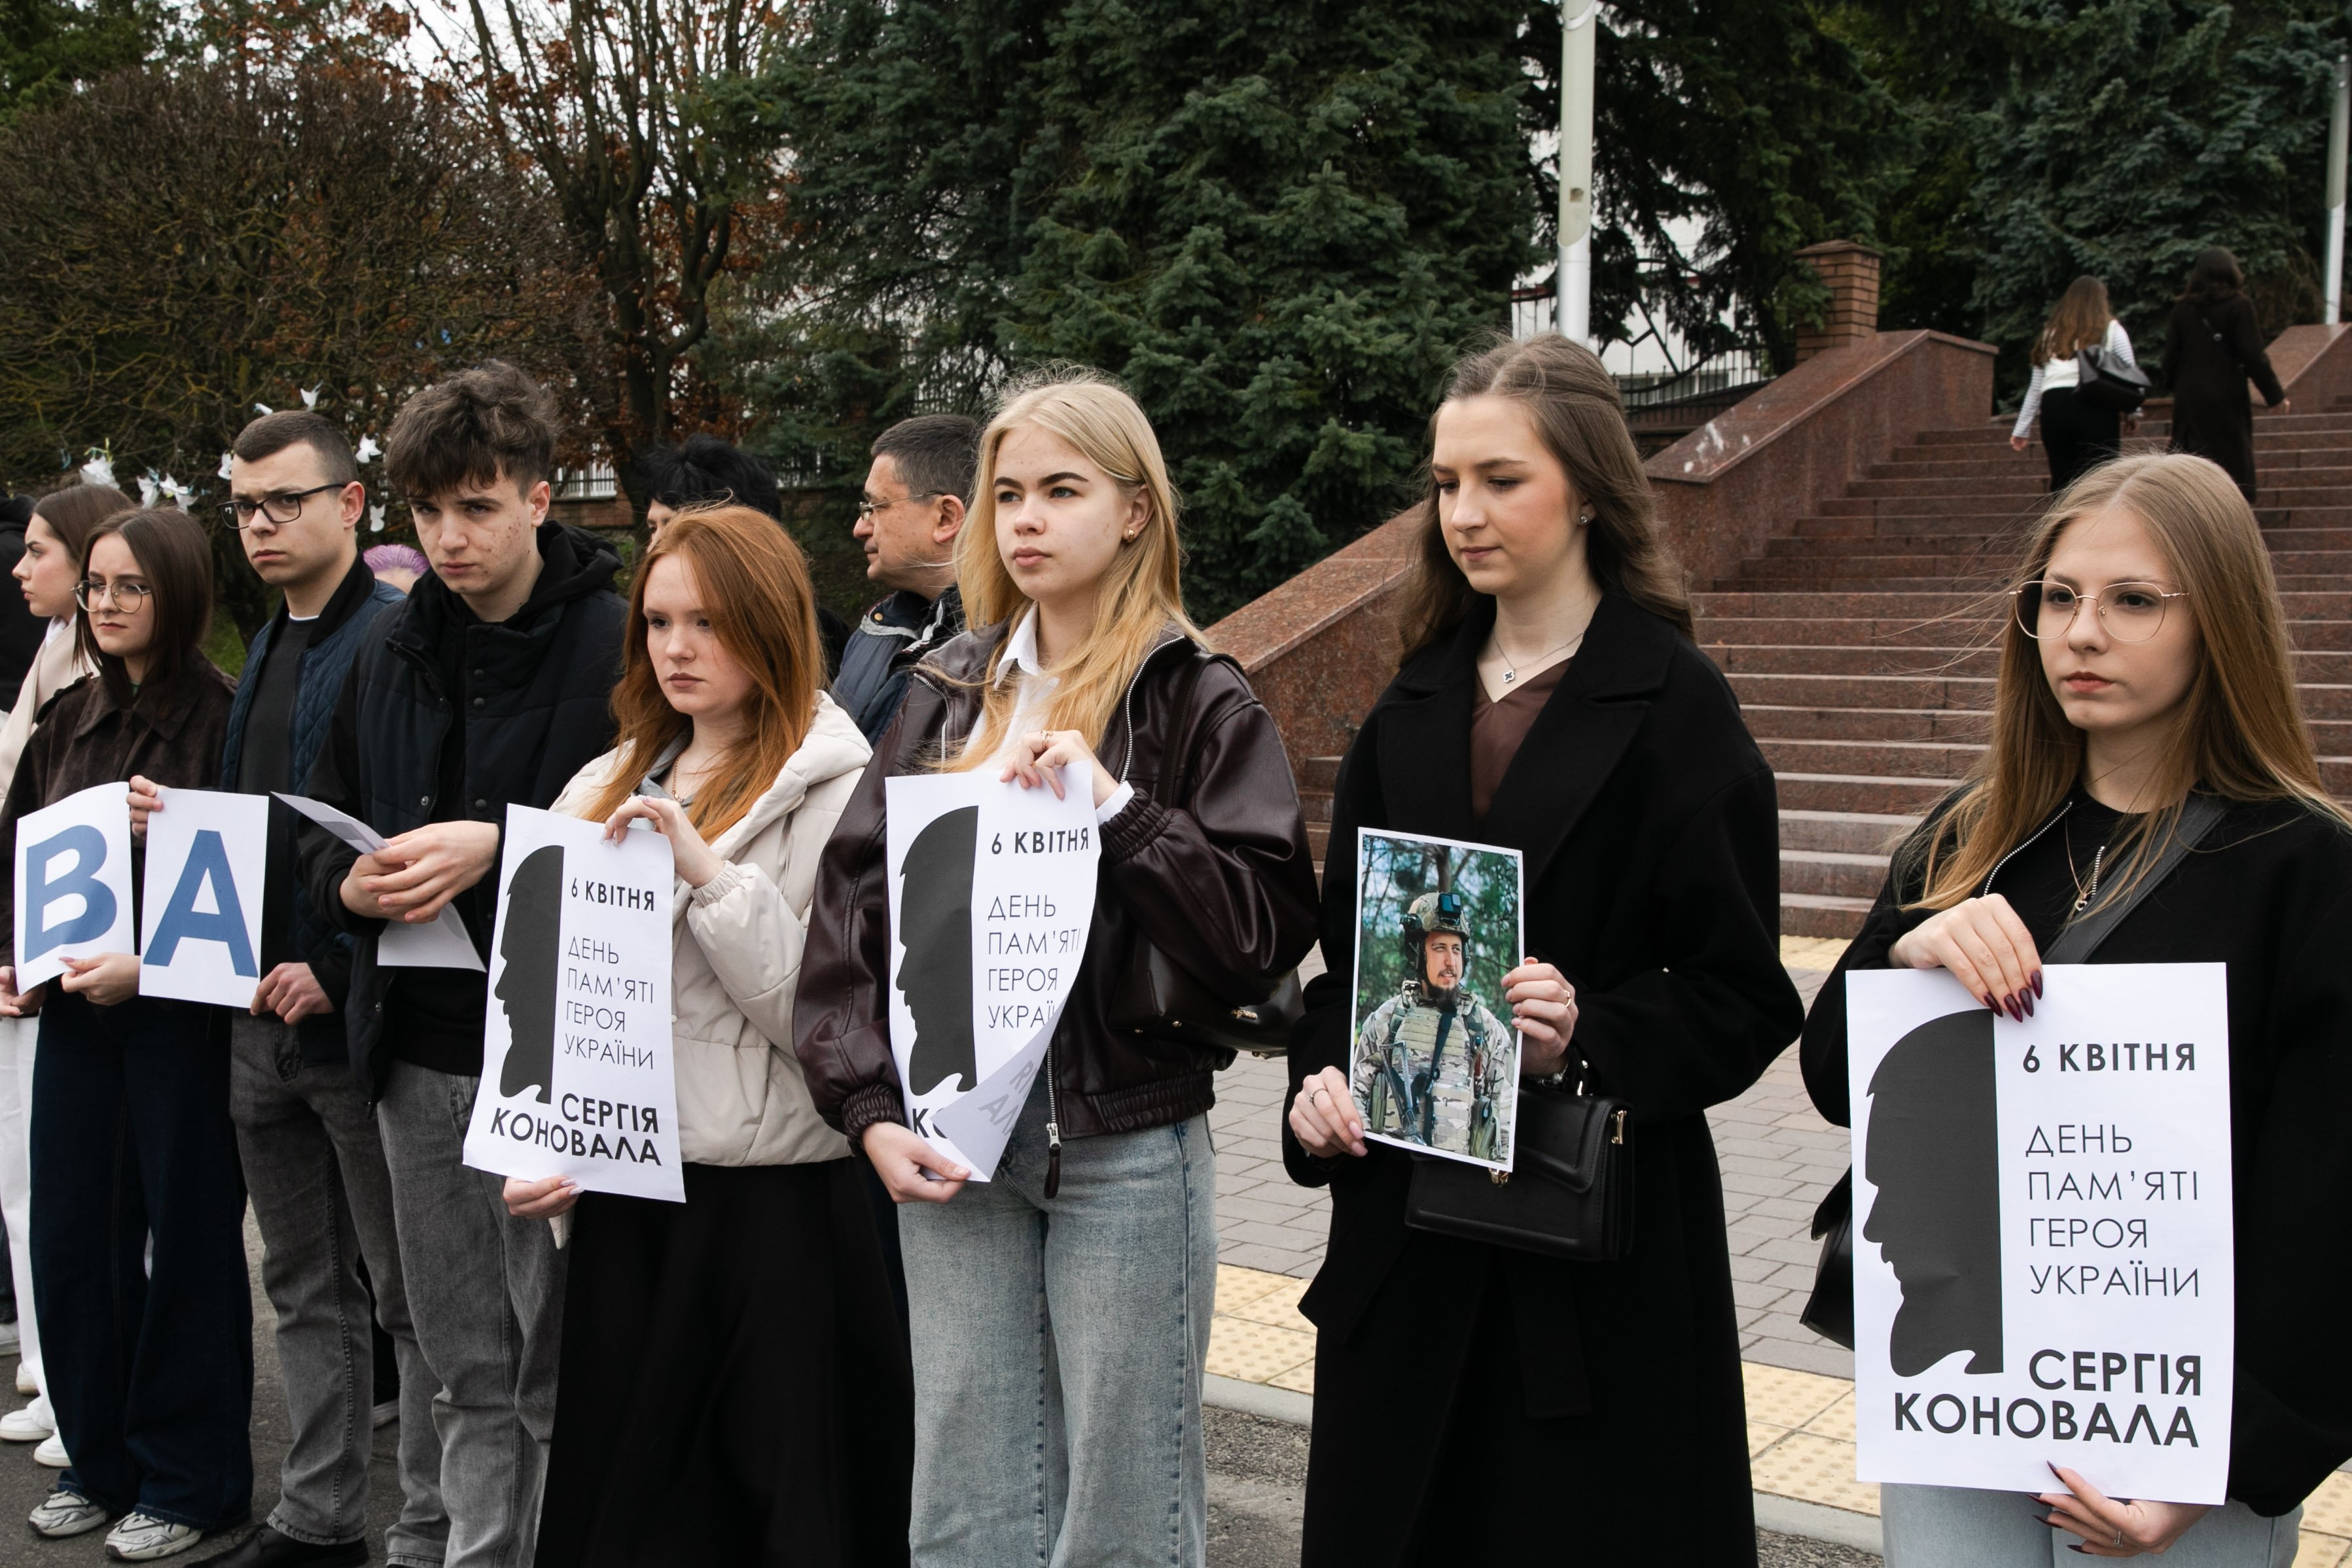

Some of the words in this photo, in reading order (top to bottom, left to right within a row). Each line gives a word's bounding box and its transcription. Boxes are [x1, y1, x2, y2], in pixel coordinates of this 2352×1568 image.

[991, 832, 1002, 855] 6
[1014, 827, 1088, 854] КВІТНЯ
[24, 825, 117, 963] В
[143, 829, 258, 978] А
[571, 877, 579, 899] 6
[586, 880, 654, 912] КВІТНЯ
[988, 895, 1056, 921] ДЕНЬ
[568, 936, 619, 965] ДЕНЬ
[989, 968, 1058, 991] ГЕРОЯ
[566, 1000, 625, 1033] ГЕРОЯ
[565, 1033, 653, 1070] УКРАЇНИ
[2023, 1044, 2040, 1073] 6
[2059, 1043, 2195, 1072] КВІТНЯ
[561, 1093, 659, 1134] СЕРГІЯ
[490, 1107, 662, 1167] КОНОВАЛА
[2025, 1124, 2132, 1158] ДЕНЬ
[2030, 1218, 2147, 1249] ГЕРОЯ
[2029, 1260, 2198, 1297] УКРАЇНИ
[2029, 1349, 2201, 1397] СЕРГІЯ
[1895, 1392, 2199, 1448] КОНОВАЛА
